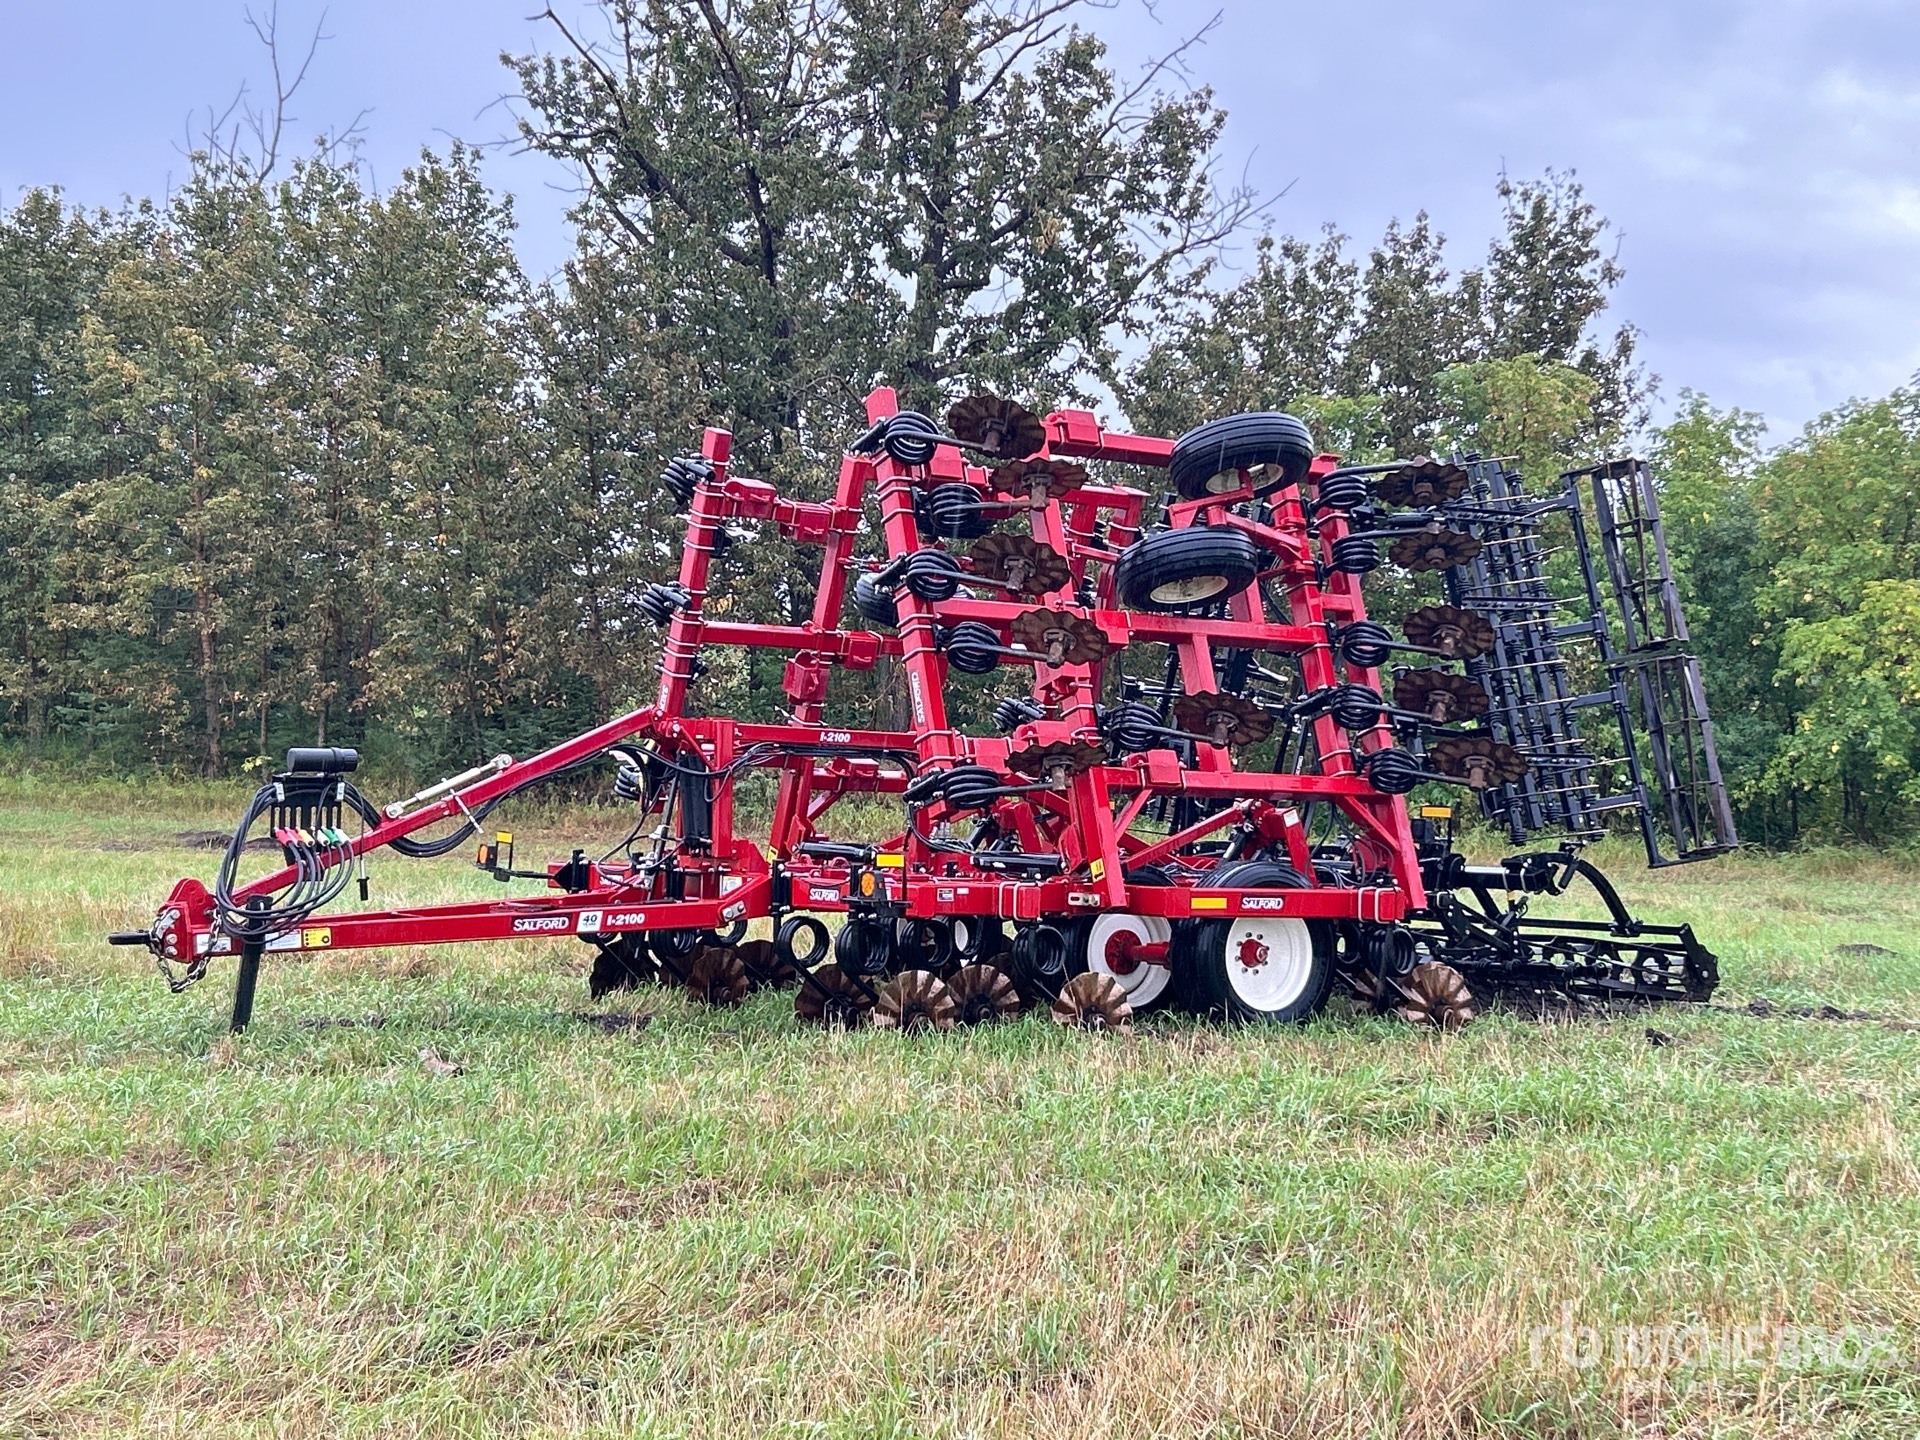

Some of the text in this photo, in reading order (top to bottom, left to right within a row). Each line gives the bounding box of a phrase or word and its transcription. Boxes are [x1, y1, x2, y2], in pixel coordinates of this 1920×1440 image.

[819, 731, 851, 742] I-2100
[809, 888, 839, 901] SALFORD
[1241, 897, 1283, 909] SALFORD
[513, 917, 569, 931] SALFORD
[582, 914, 598, 923] 40
[606, 913, 645, 926] I-2100
